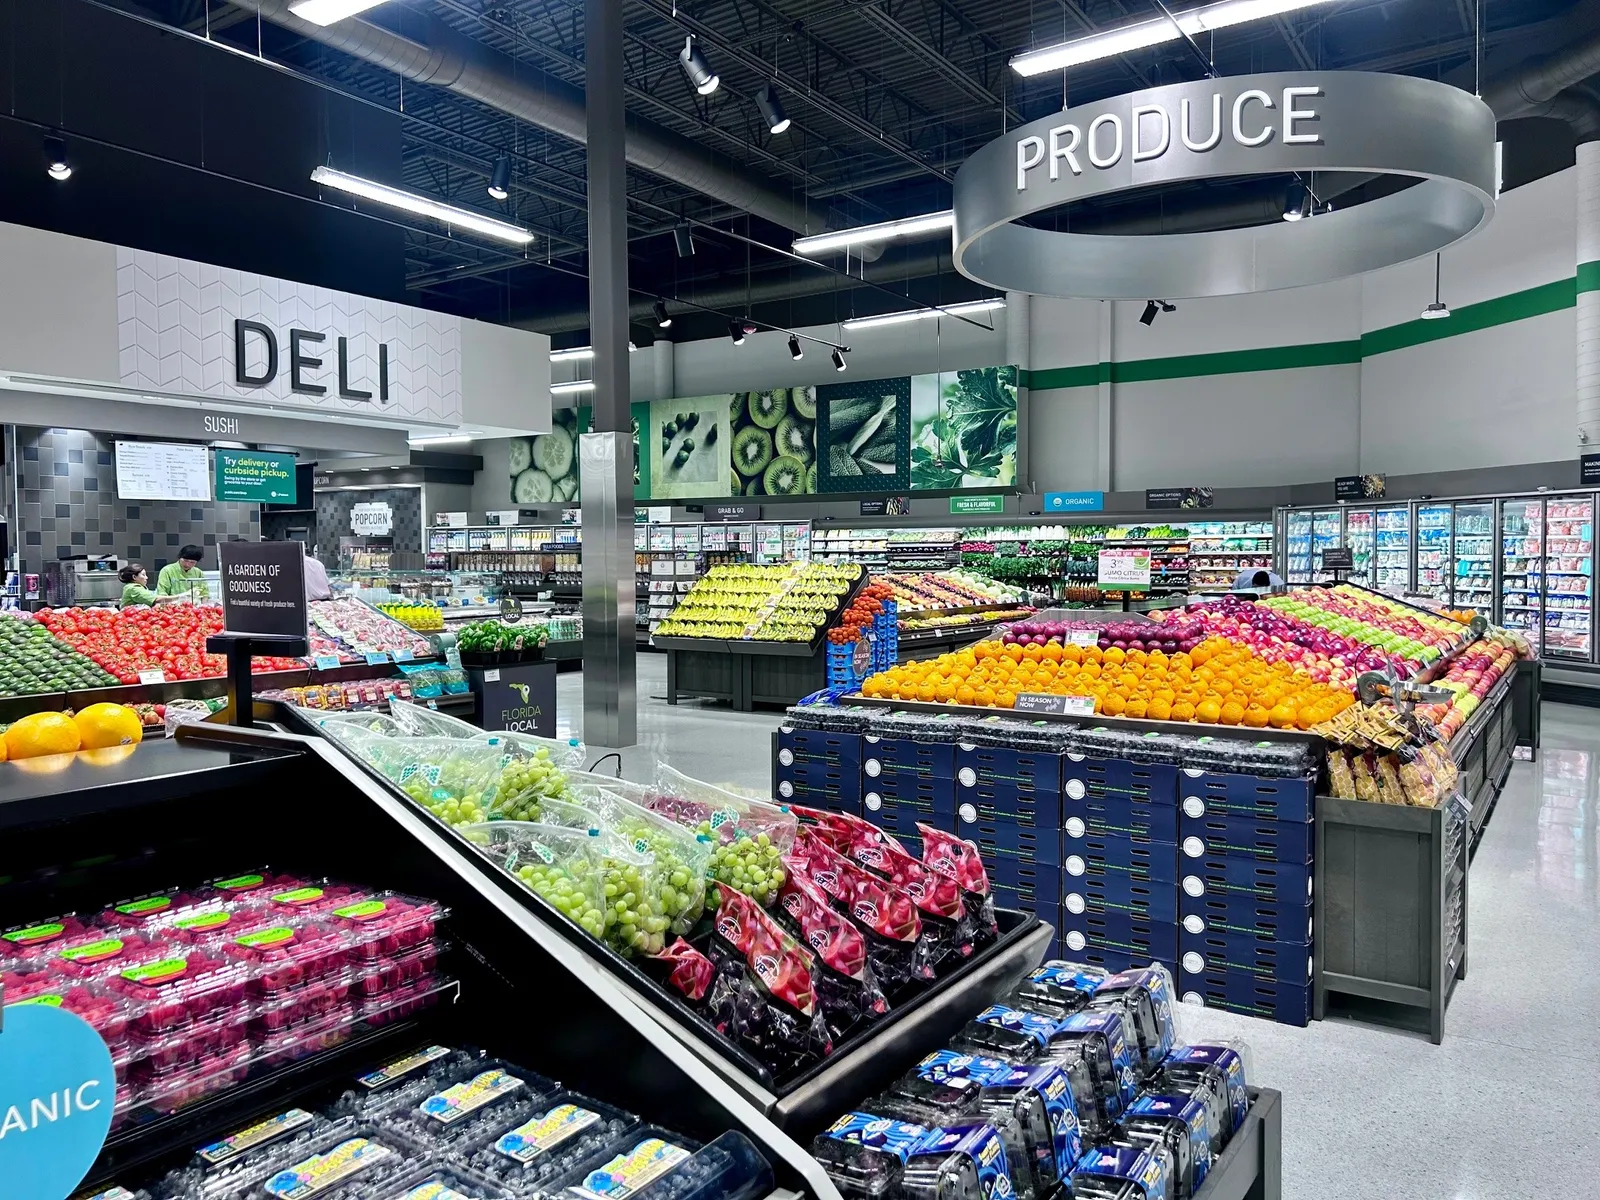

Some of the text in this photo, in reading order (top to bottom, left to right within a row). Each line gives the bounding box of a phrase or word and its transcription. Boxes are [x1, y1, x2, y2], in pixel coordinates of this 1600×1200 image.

[1016, 86, 1321, 190] PRODUCE
[235, 319, 388, 401] DELI
[204, 415, 239, 434] SUSHI
[223, 456, 236, 467] Try
[238, 458, 269, 469] delivery
[224, 466, 289, 479] curbside pickup.
[355, 512, 388, 525] POPCORN
[228, 564, 280, 576] A GARDEN OF
[229, 580, 271, 593] GOODNESS
[501, 705, 542, 721] FLORIDA
[505, 719, 539, 732] LOCAL
[0, 1079, 101, 1140] ANIC
